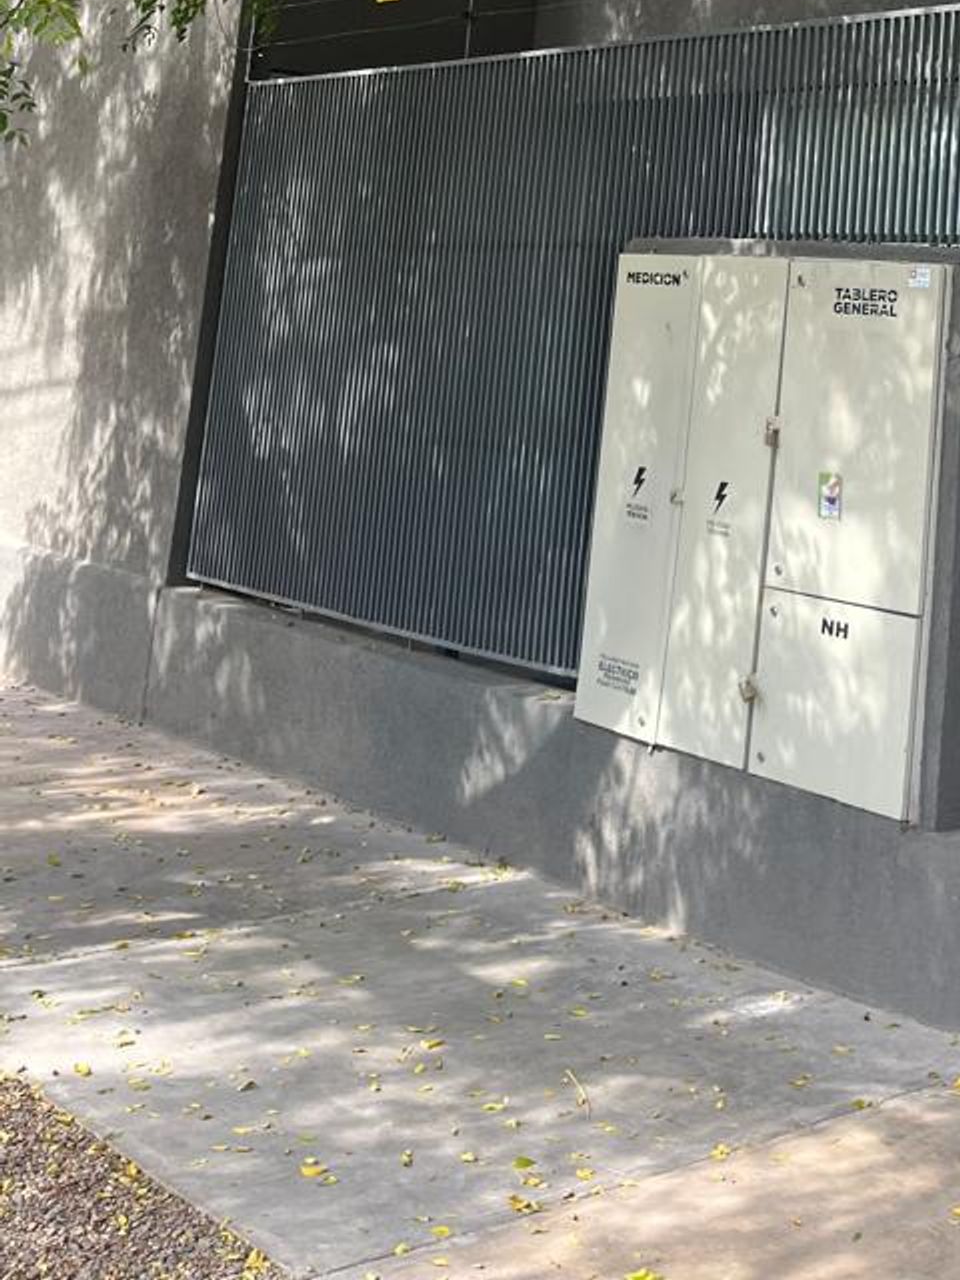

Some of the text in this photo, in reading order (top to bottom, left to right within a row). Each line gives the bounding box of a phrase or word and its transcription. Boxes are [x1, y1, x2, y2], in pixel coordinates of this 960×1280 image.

[626, 271, 681, 286] MEDICION
[834, 287, 898, 303] TABLERO
[833, 301, 897, 318] GENERAL
[821, 616, 850, 640] NH
